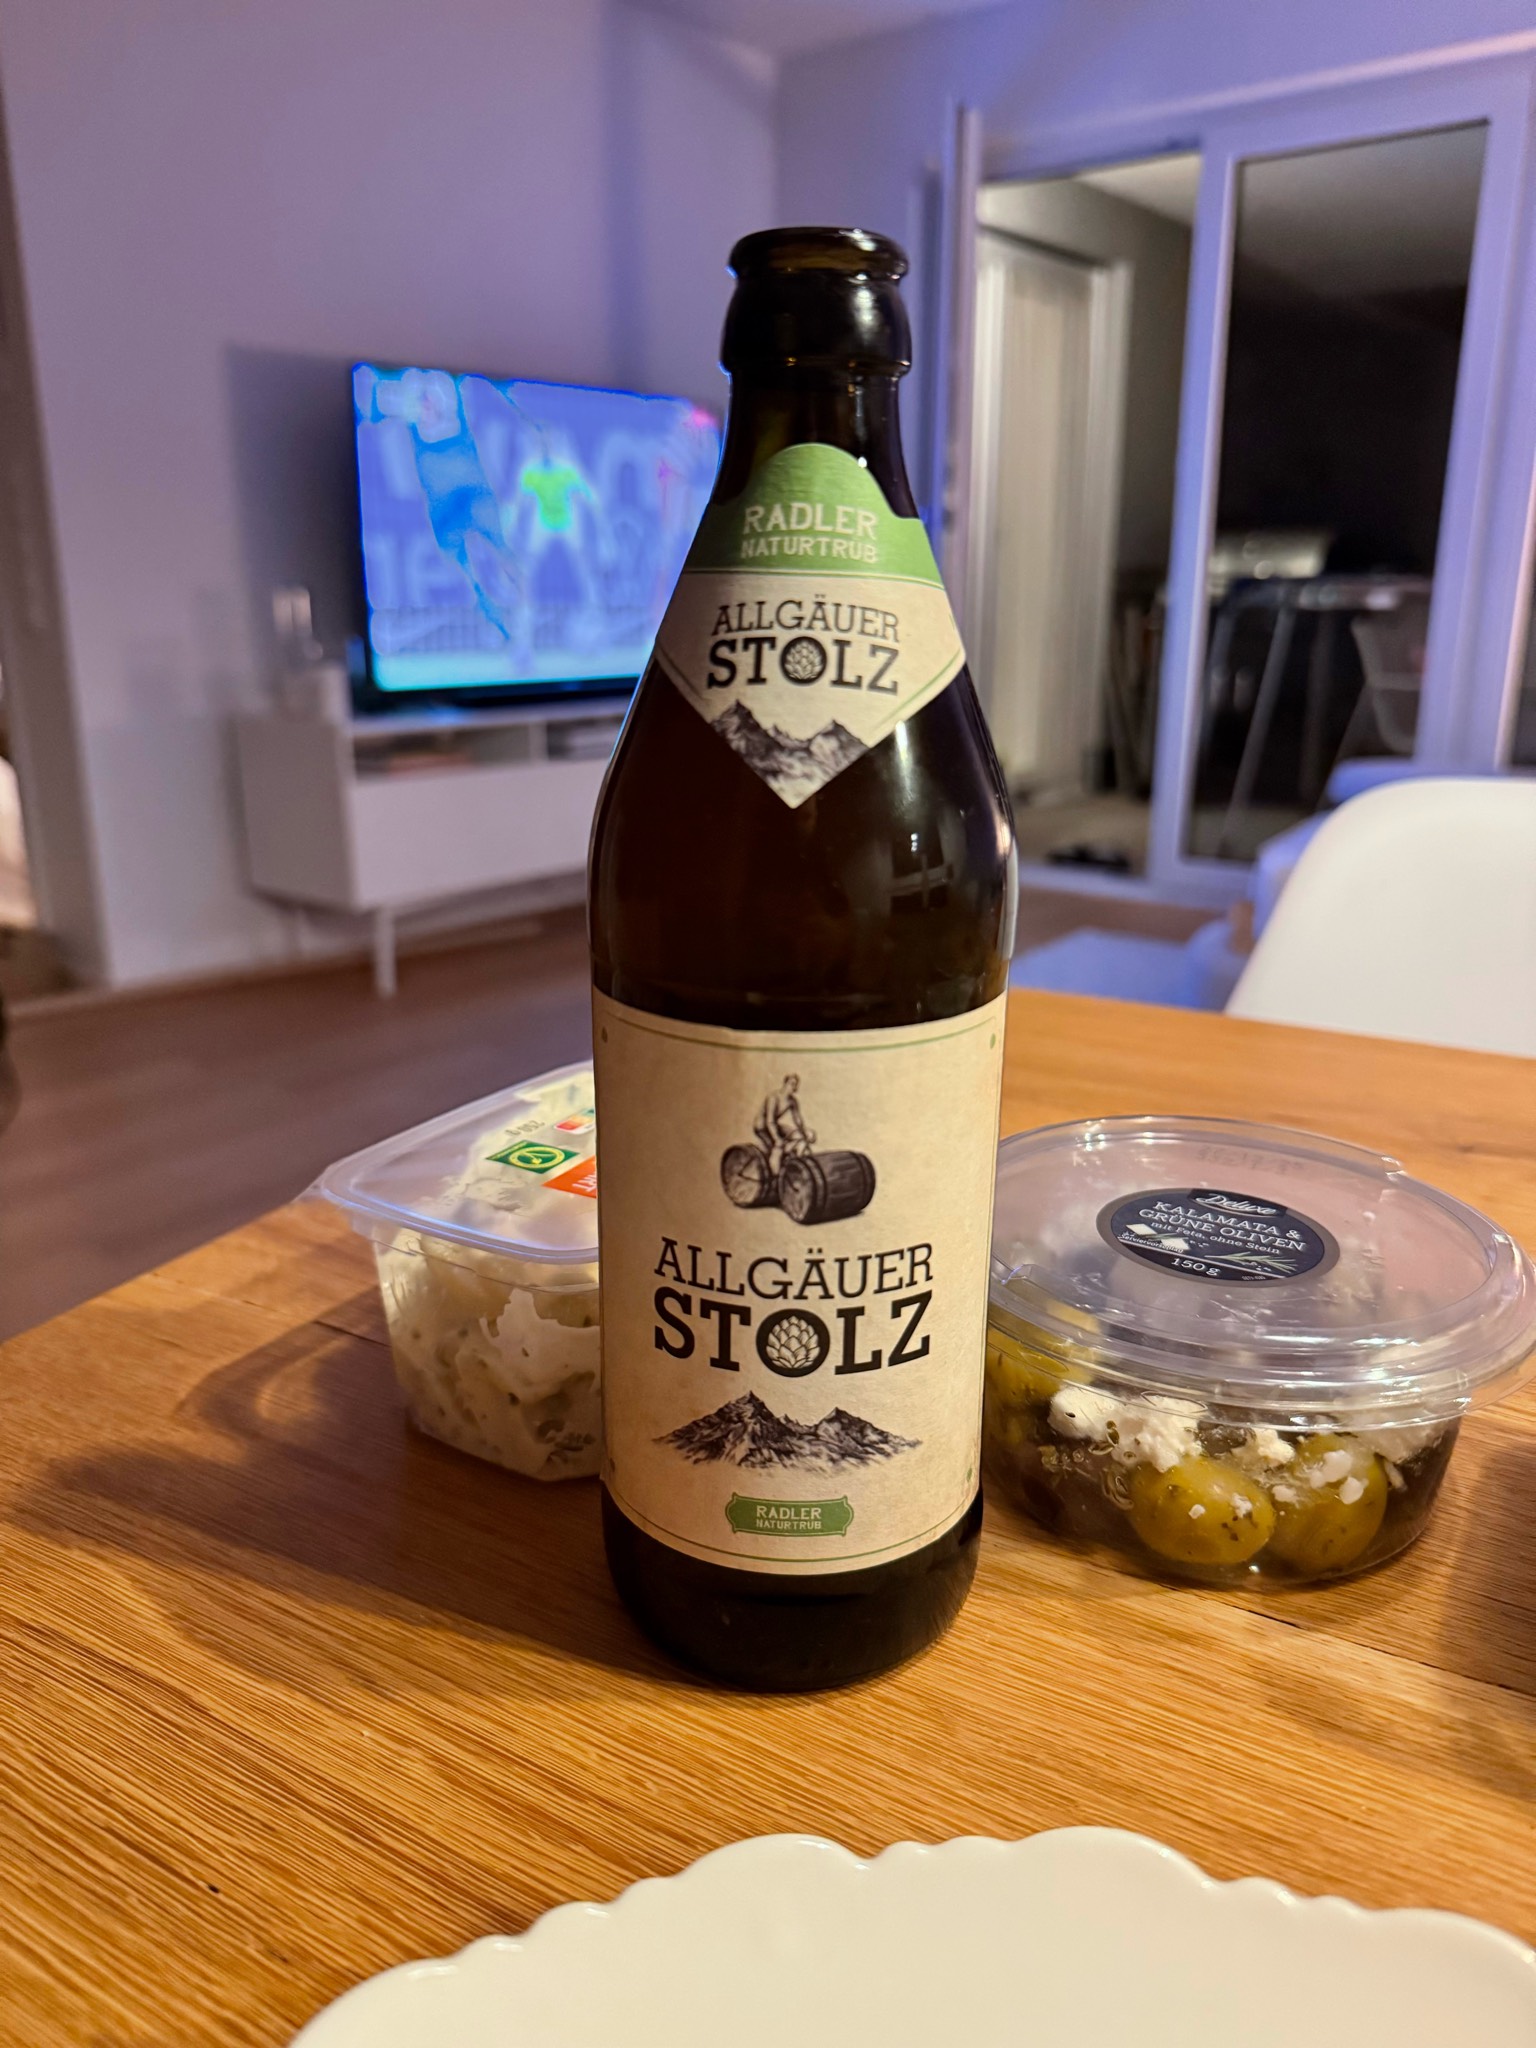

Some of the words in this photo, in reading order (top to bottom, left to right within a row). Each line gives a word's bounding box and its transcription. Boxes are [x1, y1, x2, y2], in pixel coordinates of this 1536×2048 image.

[743, 502, 878, 540] RADLER
[711, 594, 900, 643] ALLGÄUER
[707, 636, 900, 696] STOLZ
[1153, 1201, 1280, 1236] KALAMATA
[1285, 1229, 1302, 1241] &
[1195, 1193, 1277, 1216] Deluxe
[1138, 1208, 1215, 1233] GRÜNE
[1219, 1226, 1306, 1252] OLIVEN
[1151, 1221, 1174, 1231] mit
[1210, 1233, 1243, 1247] ohne
[1245, 1242, 1280, 1255] Stein
[653, 1236, 934, 1300] ALLGÄUER
[1171, 1257, 1205, 1272] 150
[1205, 1265, 1221, 1278] g
[653, 1286, 933, 1378] STOLZ
[756, 1505, 822, 1520] RADLER
